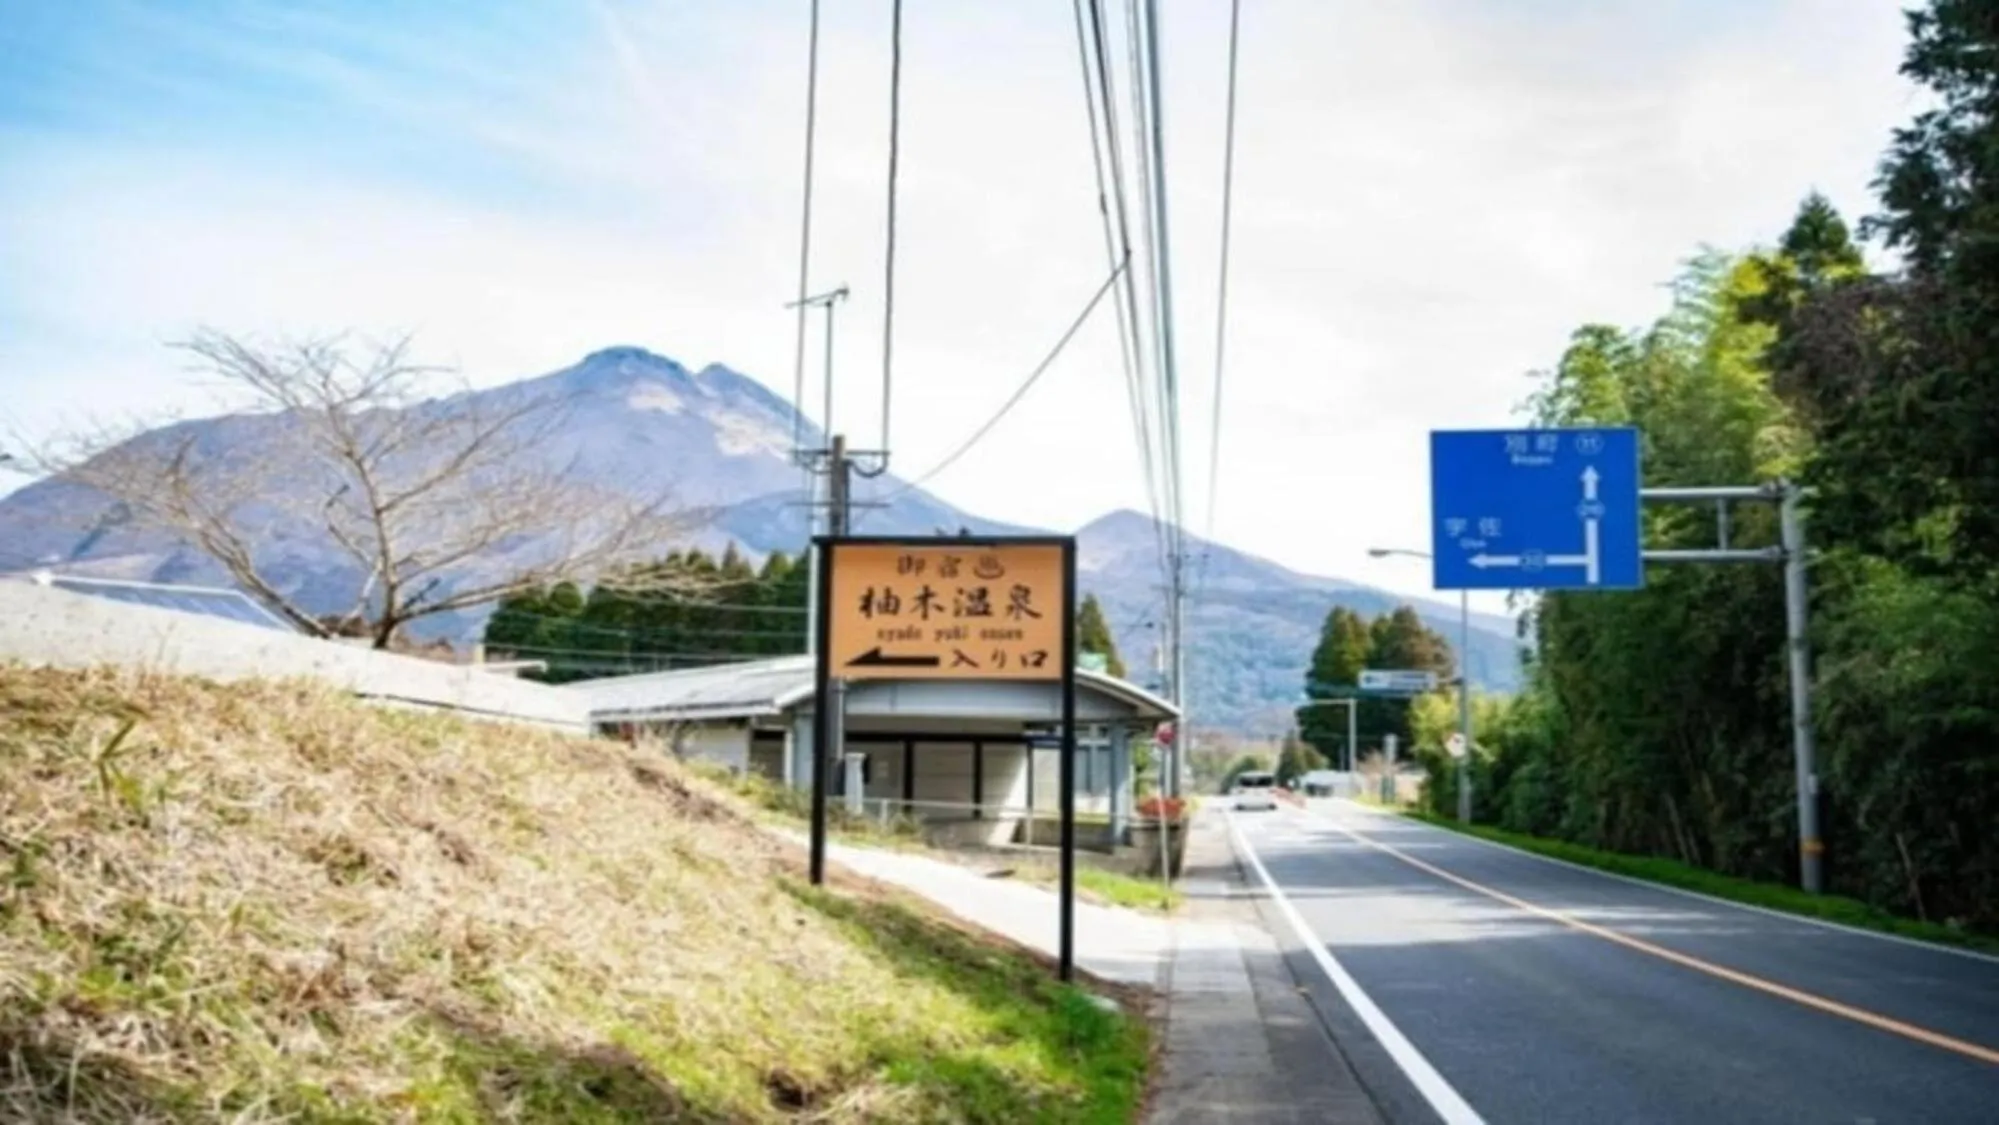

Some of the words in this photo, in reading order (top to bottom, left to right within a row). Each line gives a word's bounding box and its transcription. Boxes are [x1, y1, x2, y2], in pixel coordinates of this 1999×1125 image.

[858, 584, 1043, 621] 柚木温泉
[949, 649, 1048, 669] 入り口
